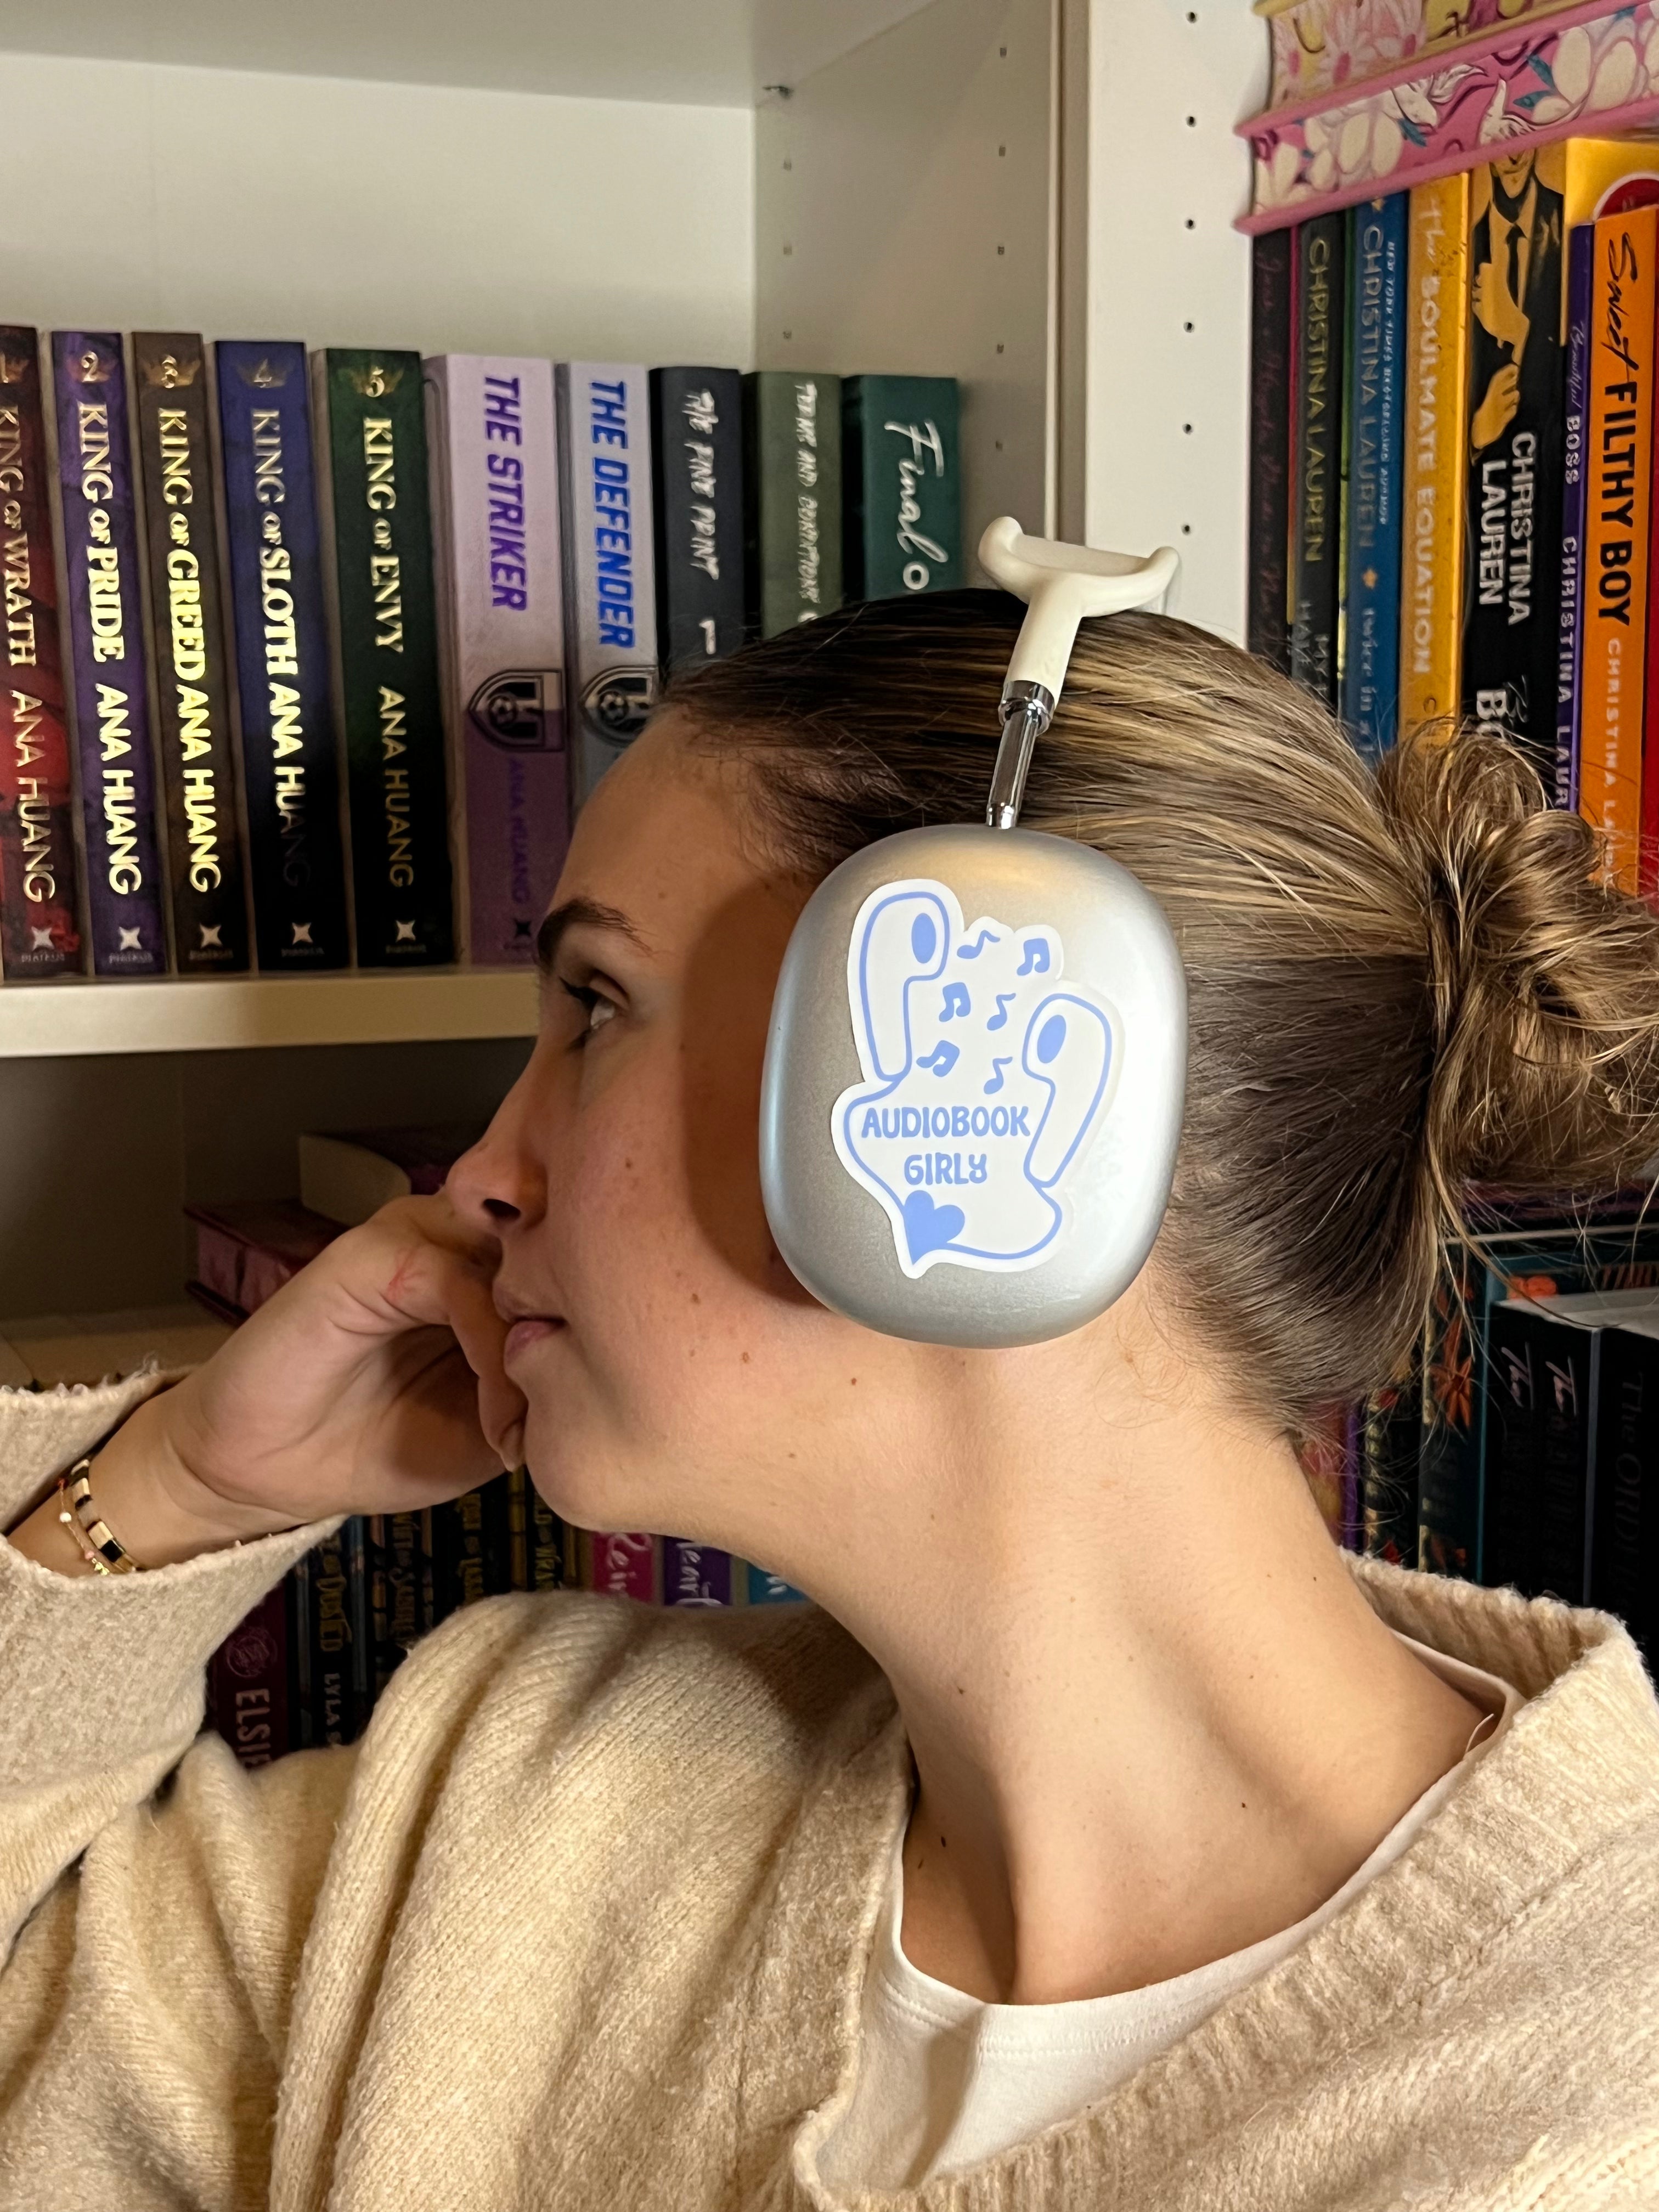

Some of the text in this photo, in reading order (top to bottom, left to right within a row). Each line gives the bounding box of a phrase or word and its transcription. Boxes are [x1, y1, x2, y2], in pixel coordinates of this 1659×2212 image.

[81, 350, 99, 382] 2
[161, 355, 178, 388] 3
[366, 366, 385, 397] 5
[1305, 237, 1330, 561] CHRISTINA LAUREN
[1357, 225, 1383, 548] CHRISTINA LAUREN
[1598, 232, 1640, 626] Sweet FILTHY BOY
[0, 405, 24, 492] KING
[77, 400, 113, 503] KING
[158, 407, 193, 504] KING
[251, 408, 285, 506] KING
[364, 418, 396, 510] KING
[484, 374, 528, 611] THE STRIKER
[589, 380, 636, 648] THE DEFENDER
[884, 418, 949, 562] Final
[1413, 276, 1441, 674] SOULMATE EQUATION
[1565, 415, 1581, 485] BOSS
[1480, 460, 1507, 605] LAUREN
[1508, 431, 1537, 626] CHRISTINA
[3, 531, 36, 667] WRATH
[87, 545, 125, 662] PRIDE
[167, 549, 206, 681] GREED
[260, 547, 298, 675] SLOTH
[370, 555, 403, 653] ENVY
[698, 619, 716, 654] 1
[1558, 535, 1578, 704] CHRISTINA
[268, 682, 303, 759] ANA
[1604, 637, 1621, 788] CHRISTINA
[9, 689, 55, 903] ANA HUANG
[95, 683, 142, 895] ANA HUANG
[176, 684, 221, 893] ANA HUANG
[378, 685, 414, 887] ANA HUANG
[861, 1105, 1031, 1139] AUDIOBOOK
[904, 1152, 988, 1186] GIRLY
